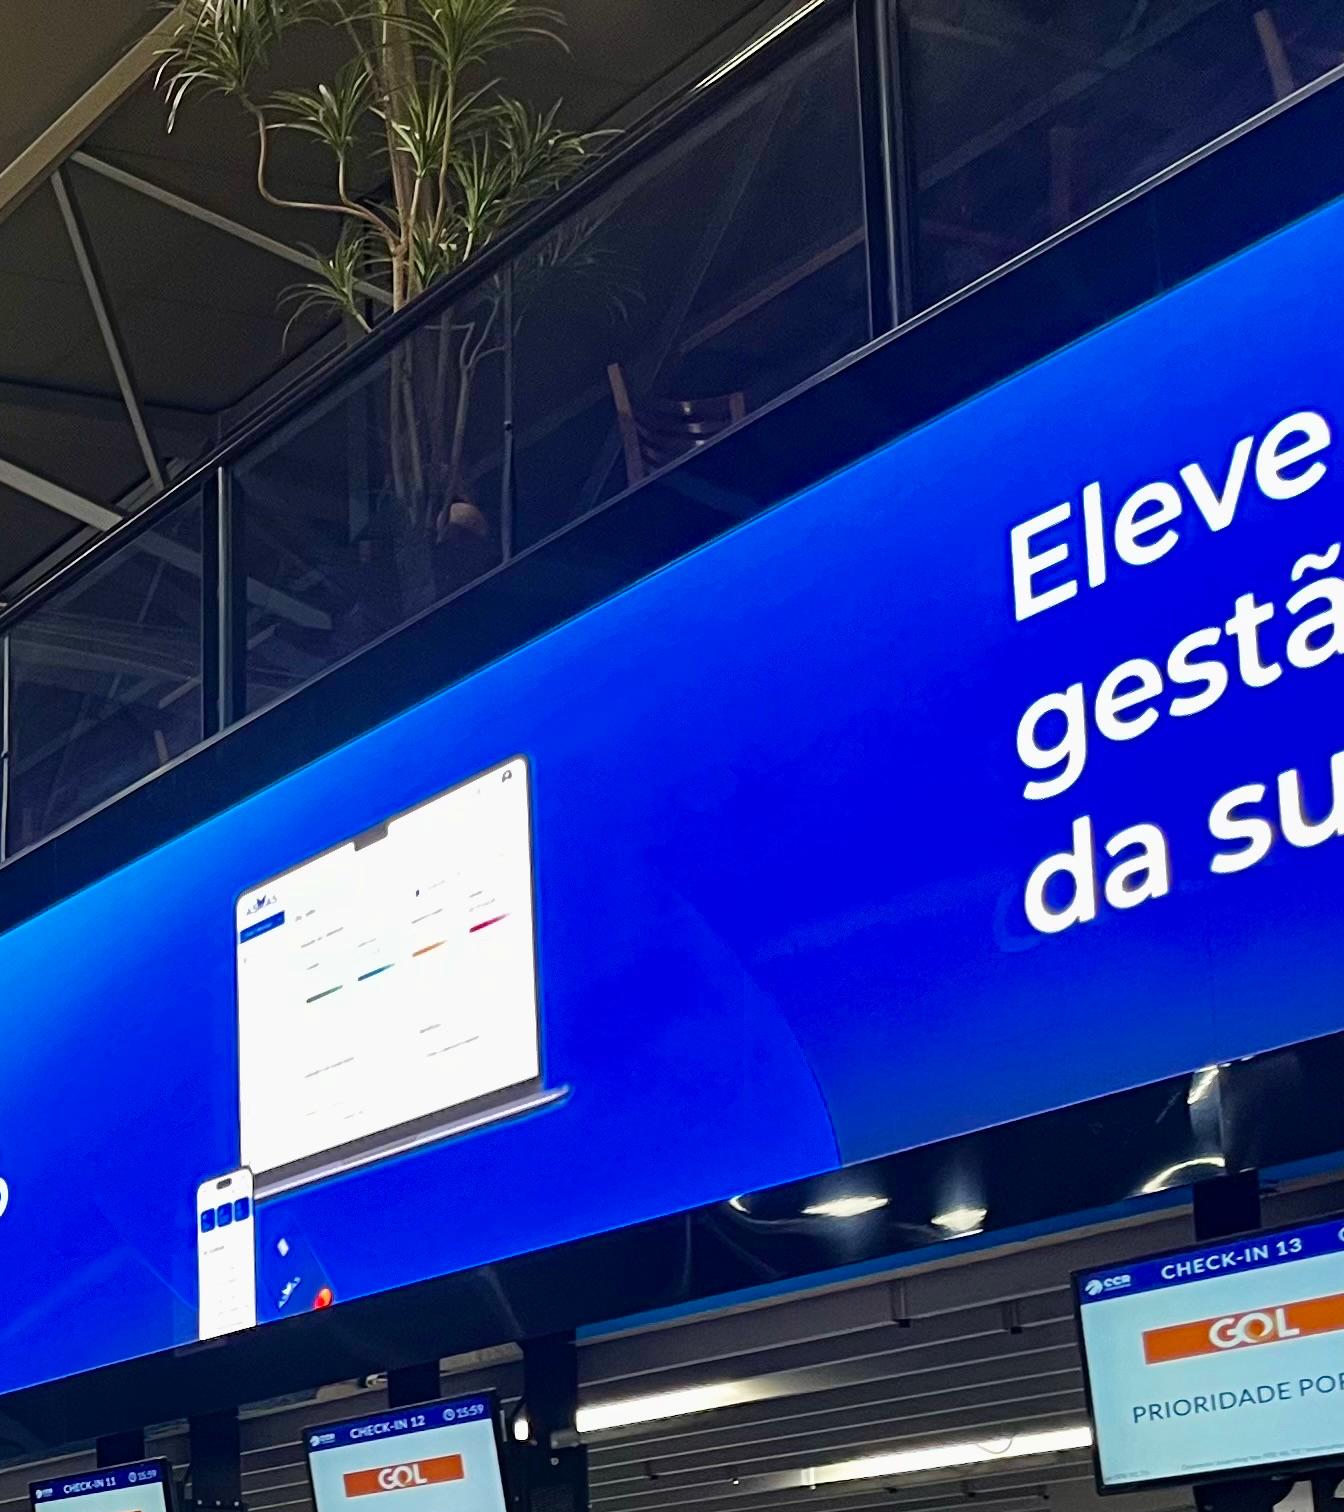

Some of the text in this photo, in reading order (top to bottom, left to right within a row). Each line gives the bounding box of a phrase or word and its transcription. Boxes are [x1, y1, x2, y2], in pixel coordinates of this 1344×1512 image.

[1010, 410, 1331, 623] Eleve
[1016, 542, 1344, 801] gestã
[1023, 750, 1344, 935] da su
[1160, 1237, 1303, 1280] CHECK-IN 13
[1208, 1307, 1301, 1350] GOL
[1132, 1382, 1292, 1424] PRIORIDADE
[349, 1418, 408, 1440] CHECK-IN
[410, 1415, 426, 1428] 12
[63, 1476, 117, 1495] CHECK-IN 11
[377, 1464, 428, 1491] GOL
